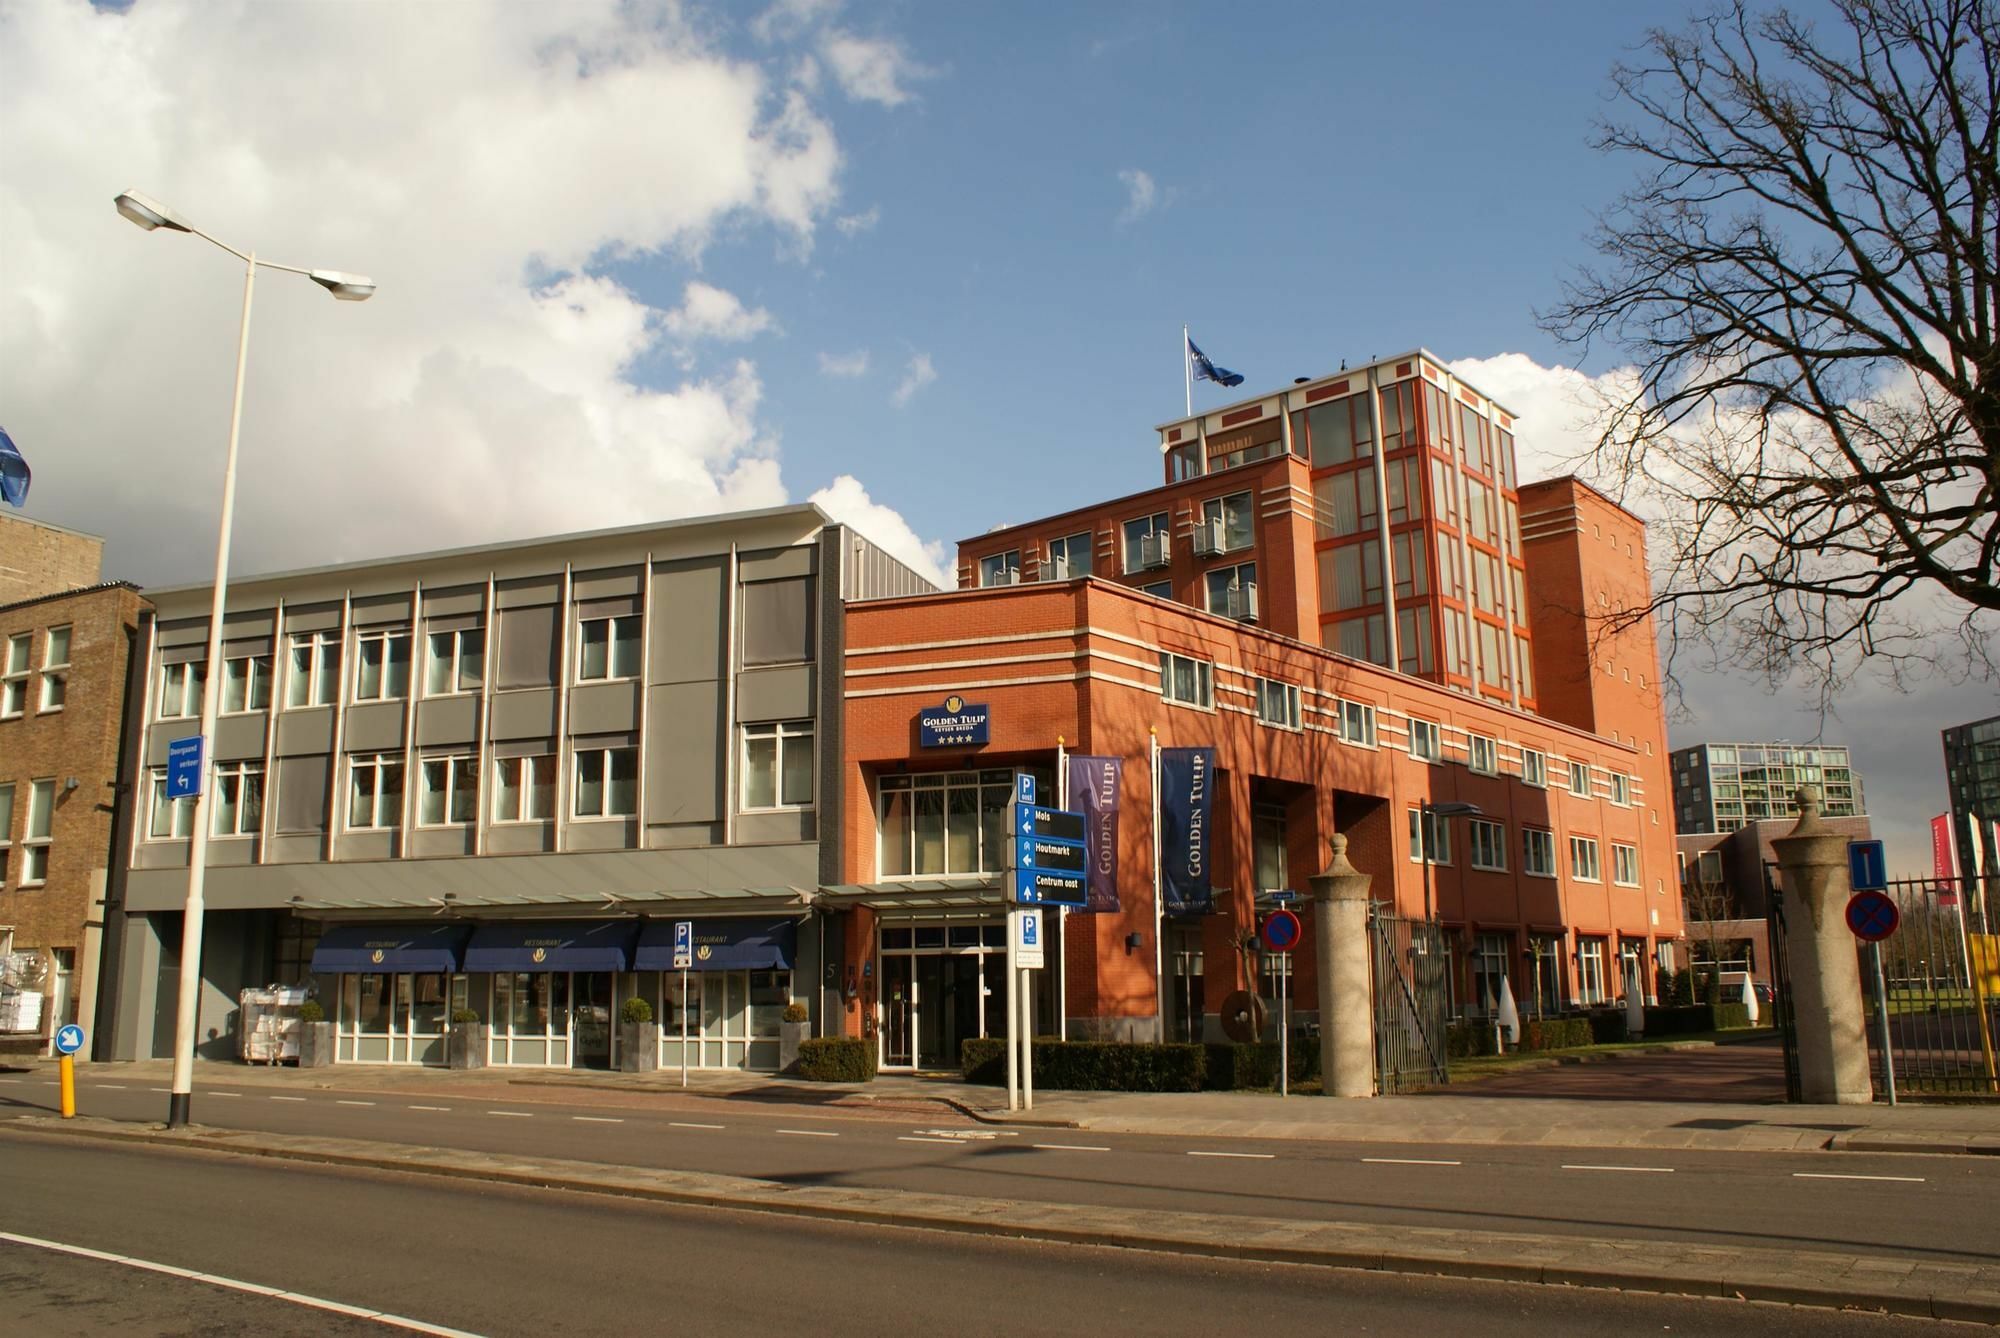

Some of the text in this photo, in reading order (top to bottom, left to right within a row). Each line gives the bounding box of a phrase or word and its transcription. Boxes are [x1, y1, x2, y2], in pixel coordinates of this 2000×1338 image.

[923, 715, 986, 727] GOLDEN TULIP
[1022, 777, 1031, 793] P
[1024, 808, 1029, 817] P
[1098, 762, 1115, 874] GOLDEN TULIP
[1188, 754, 1205, 877] GOLDEN TULIP
[1035, 842, 1070, 856] Houtmarkt
[1036, 875, 1078, 888] Centrum oost
[1025, 918, 1034, 933] P
[678, 925, 687, 942] P
[692, 935, 728, 944] ESTAURANT
[827, 963, 836, 978] 5
